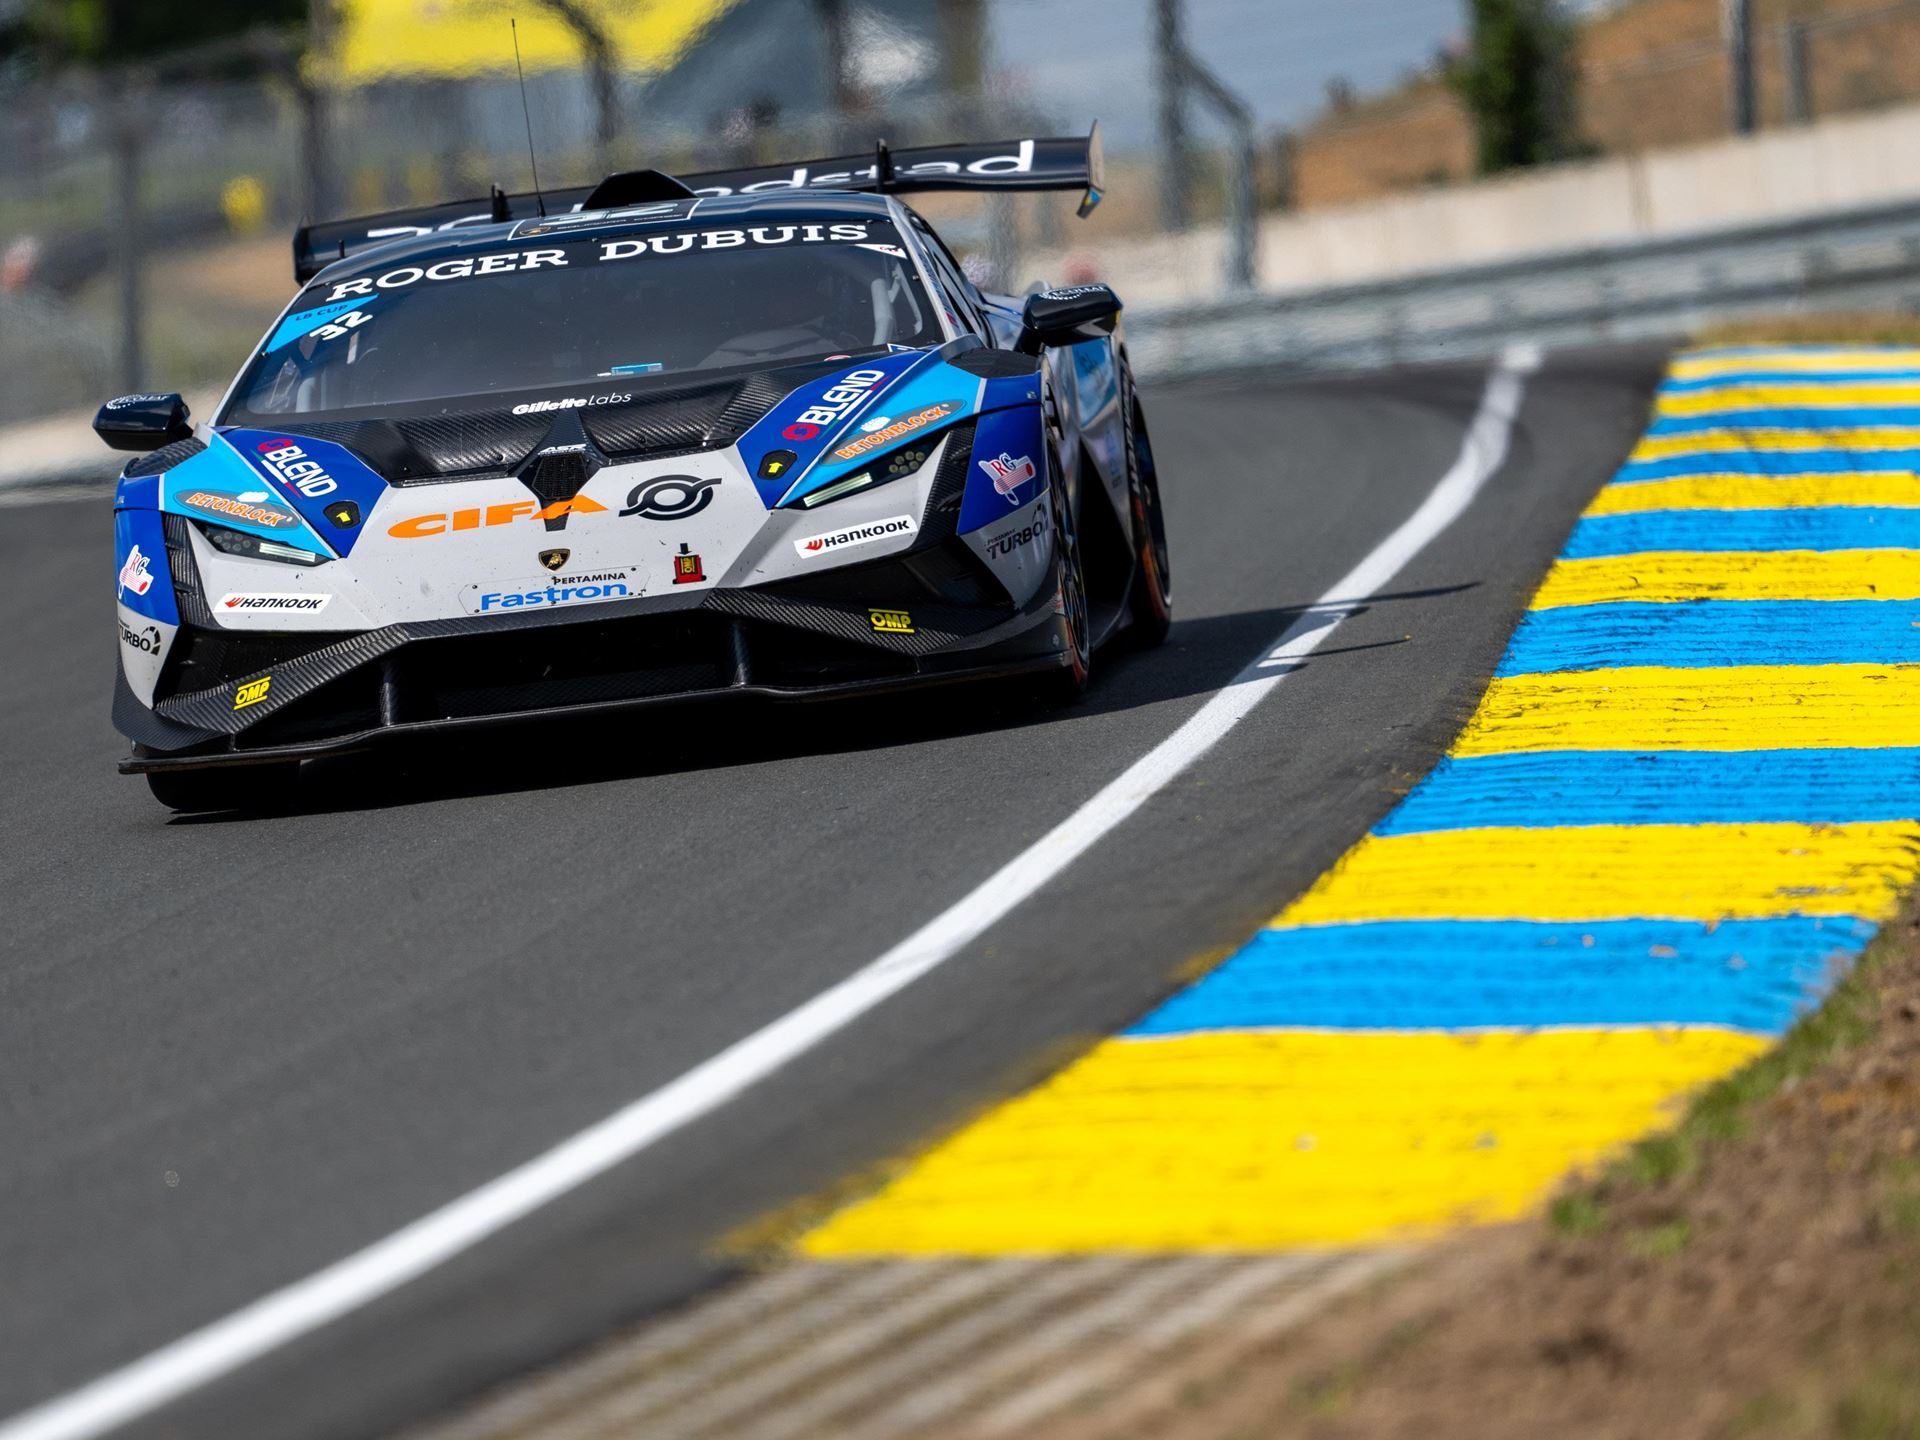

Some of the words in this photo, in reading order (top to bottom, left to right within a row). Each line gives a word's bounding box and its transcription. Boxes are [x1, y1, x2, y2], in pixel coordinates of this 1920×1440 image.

[326, 248, 568, 302] ROGER
[599, 224, 869, 261] DUBUIS
[317, 304, 348, 316] CUP
[309, 311, 373, 341] 32
[834, 405, 952, 460] BETONBLOCK
[186, 492, 284, 528] BETONBLOCK
[387, 494, 610, 539] CIFA
[986, 521, 1043, 560] TURBO
[554, 572, 627, 586] PERTAMINA
[481, 583, 627, 611] Fastron
[871, 612, 911, 629] OMP
[235, 680, 271, 706] OMP
